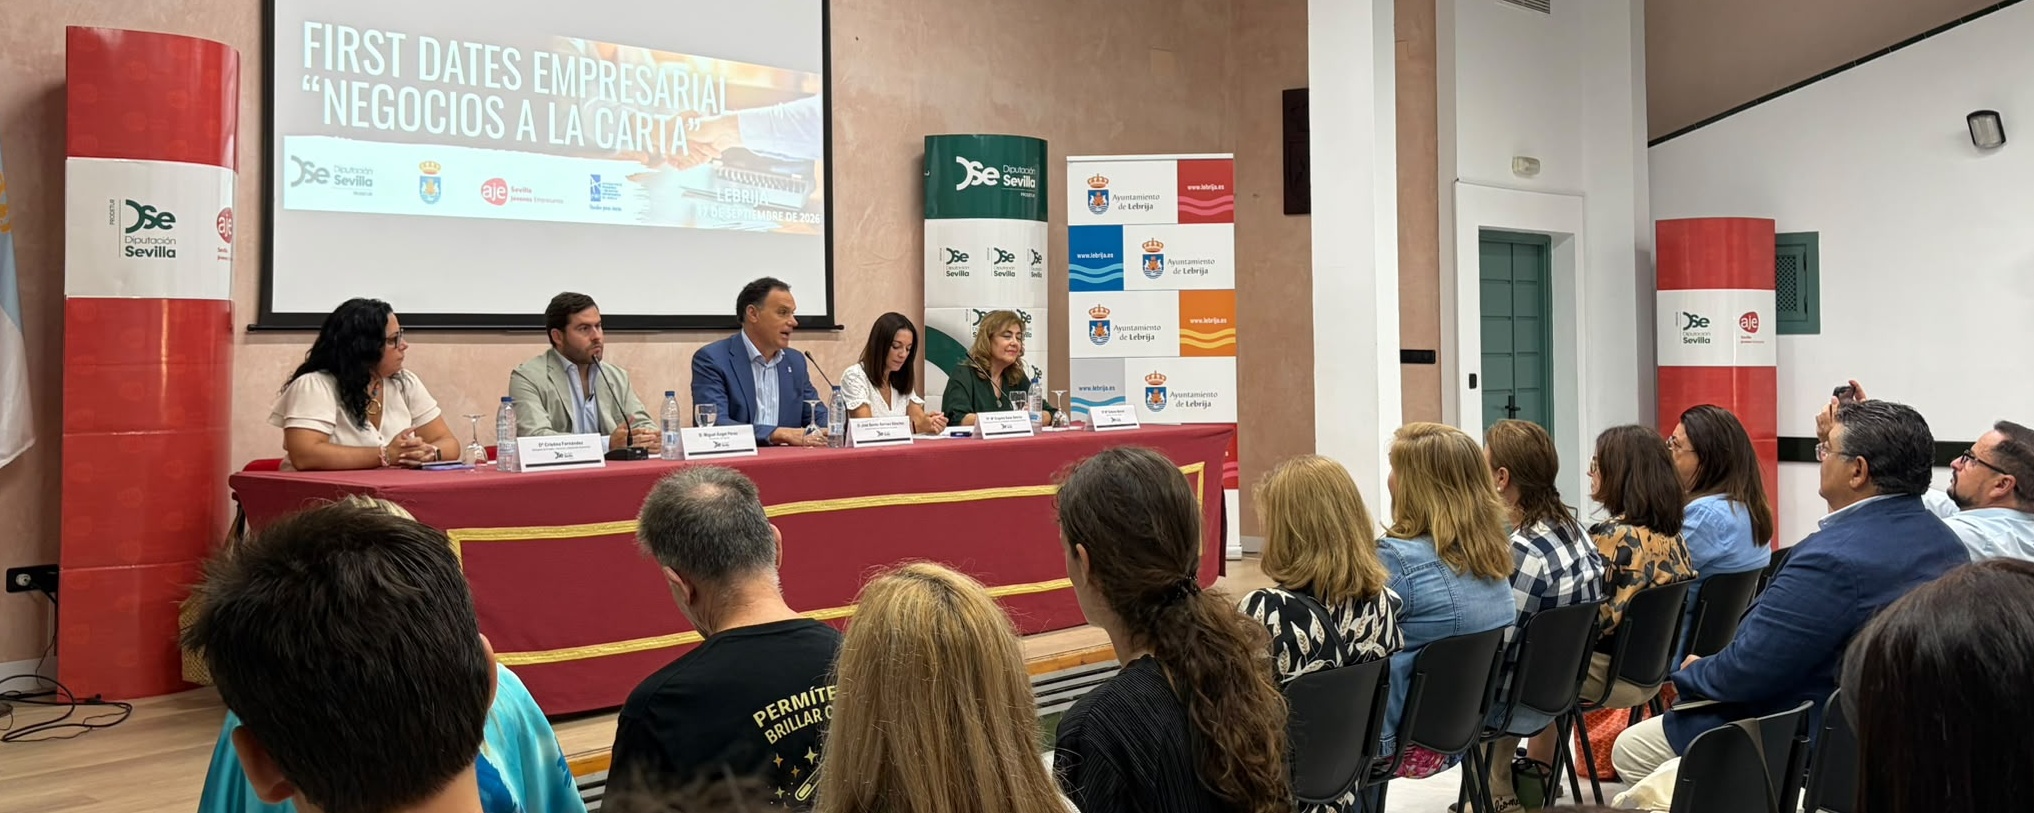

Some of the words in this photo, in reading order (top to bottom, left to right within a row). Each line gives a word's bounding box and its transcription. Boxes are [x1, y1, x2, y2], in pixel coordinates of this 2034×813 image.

[304, 21, 406, 78] FIRST
[419, 36, 522, 91] DATES
[533, 51, 729, 115] EMPRESARIAL
[302, 75, 505, 139] “NEGOCIOS
[515, 99, 537, 142] A
[548, 102, 584, 146] LA
[595, 107, 700, 156] CARTA”
[1003, 164, 1035, 174] Diputación
[334, 174, 373, 187] Sevilla
[1003, 174, 1035, 188] Sevilla
[483, 183, 506, 200] aje
[717, 187, 769, 207] LEBRIJA
[1112, 194, 1160, 203] Ayuntamiento
[1128, 203, 1153, 211] Lebrija
[727, 207, 783, 221] SEPTIEMBRE
[785, 211, 798, 223] DE
[800, 212, 820, 224] 2026
[125, 235, 176, 245] Diputación
[125, 245, 176, 258] Sevilla
[1077, 252, 1114, 260] www.lebrija.es
[1167, 258, 1215, 267] Ayuntamiento
[1173, 267, 1182, 275] de
[1183, 267, 1209, 275] Lebrija
[1190, 317, 1227, 325] www.lebrija.es
[1740, 315, 1758, 330] aje
[1113, 324, 1161, 332] Ayuntamiento
[1119, 333, 1128, 341] de
[1129, 333, 1155, 342] Lebrija
[1683, 336, 1711, 344] Sevilla
[1169, 391, 1218, 400] Ayuntamiento
[1175, 400, 1184, 408] de
[1186, 400, 1211, 409] Lebrija
[764, 707, 823, 745] BRILLAR
